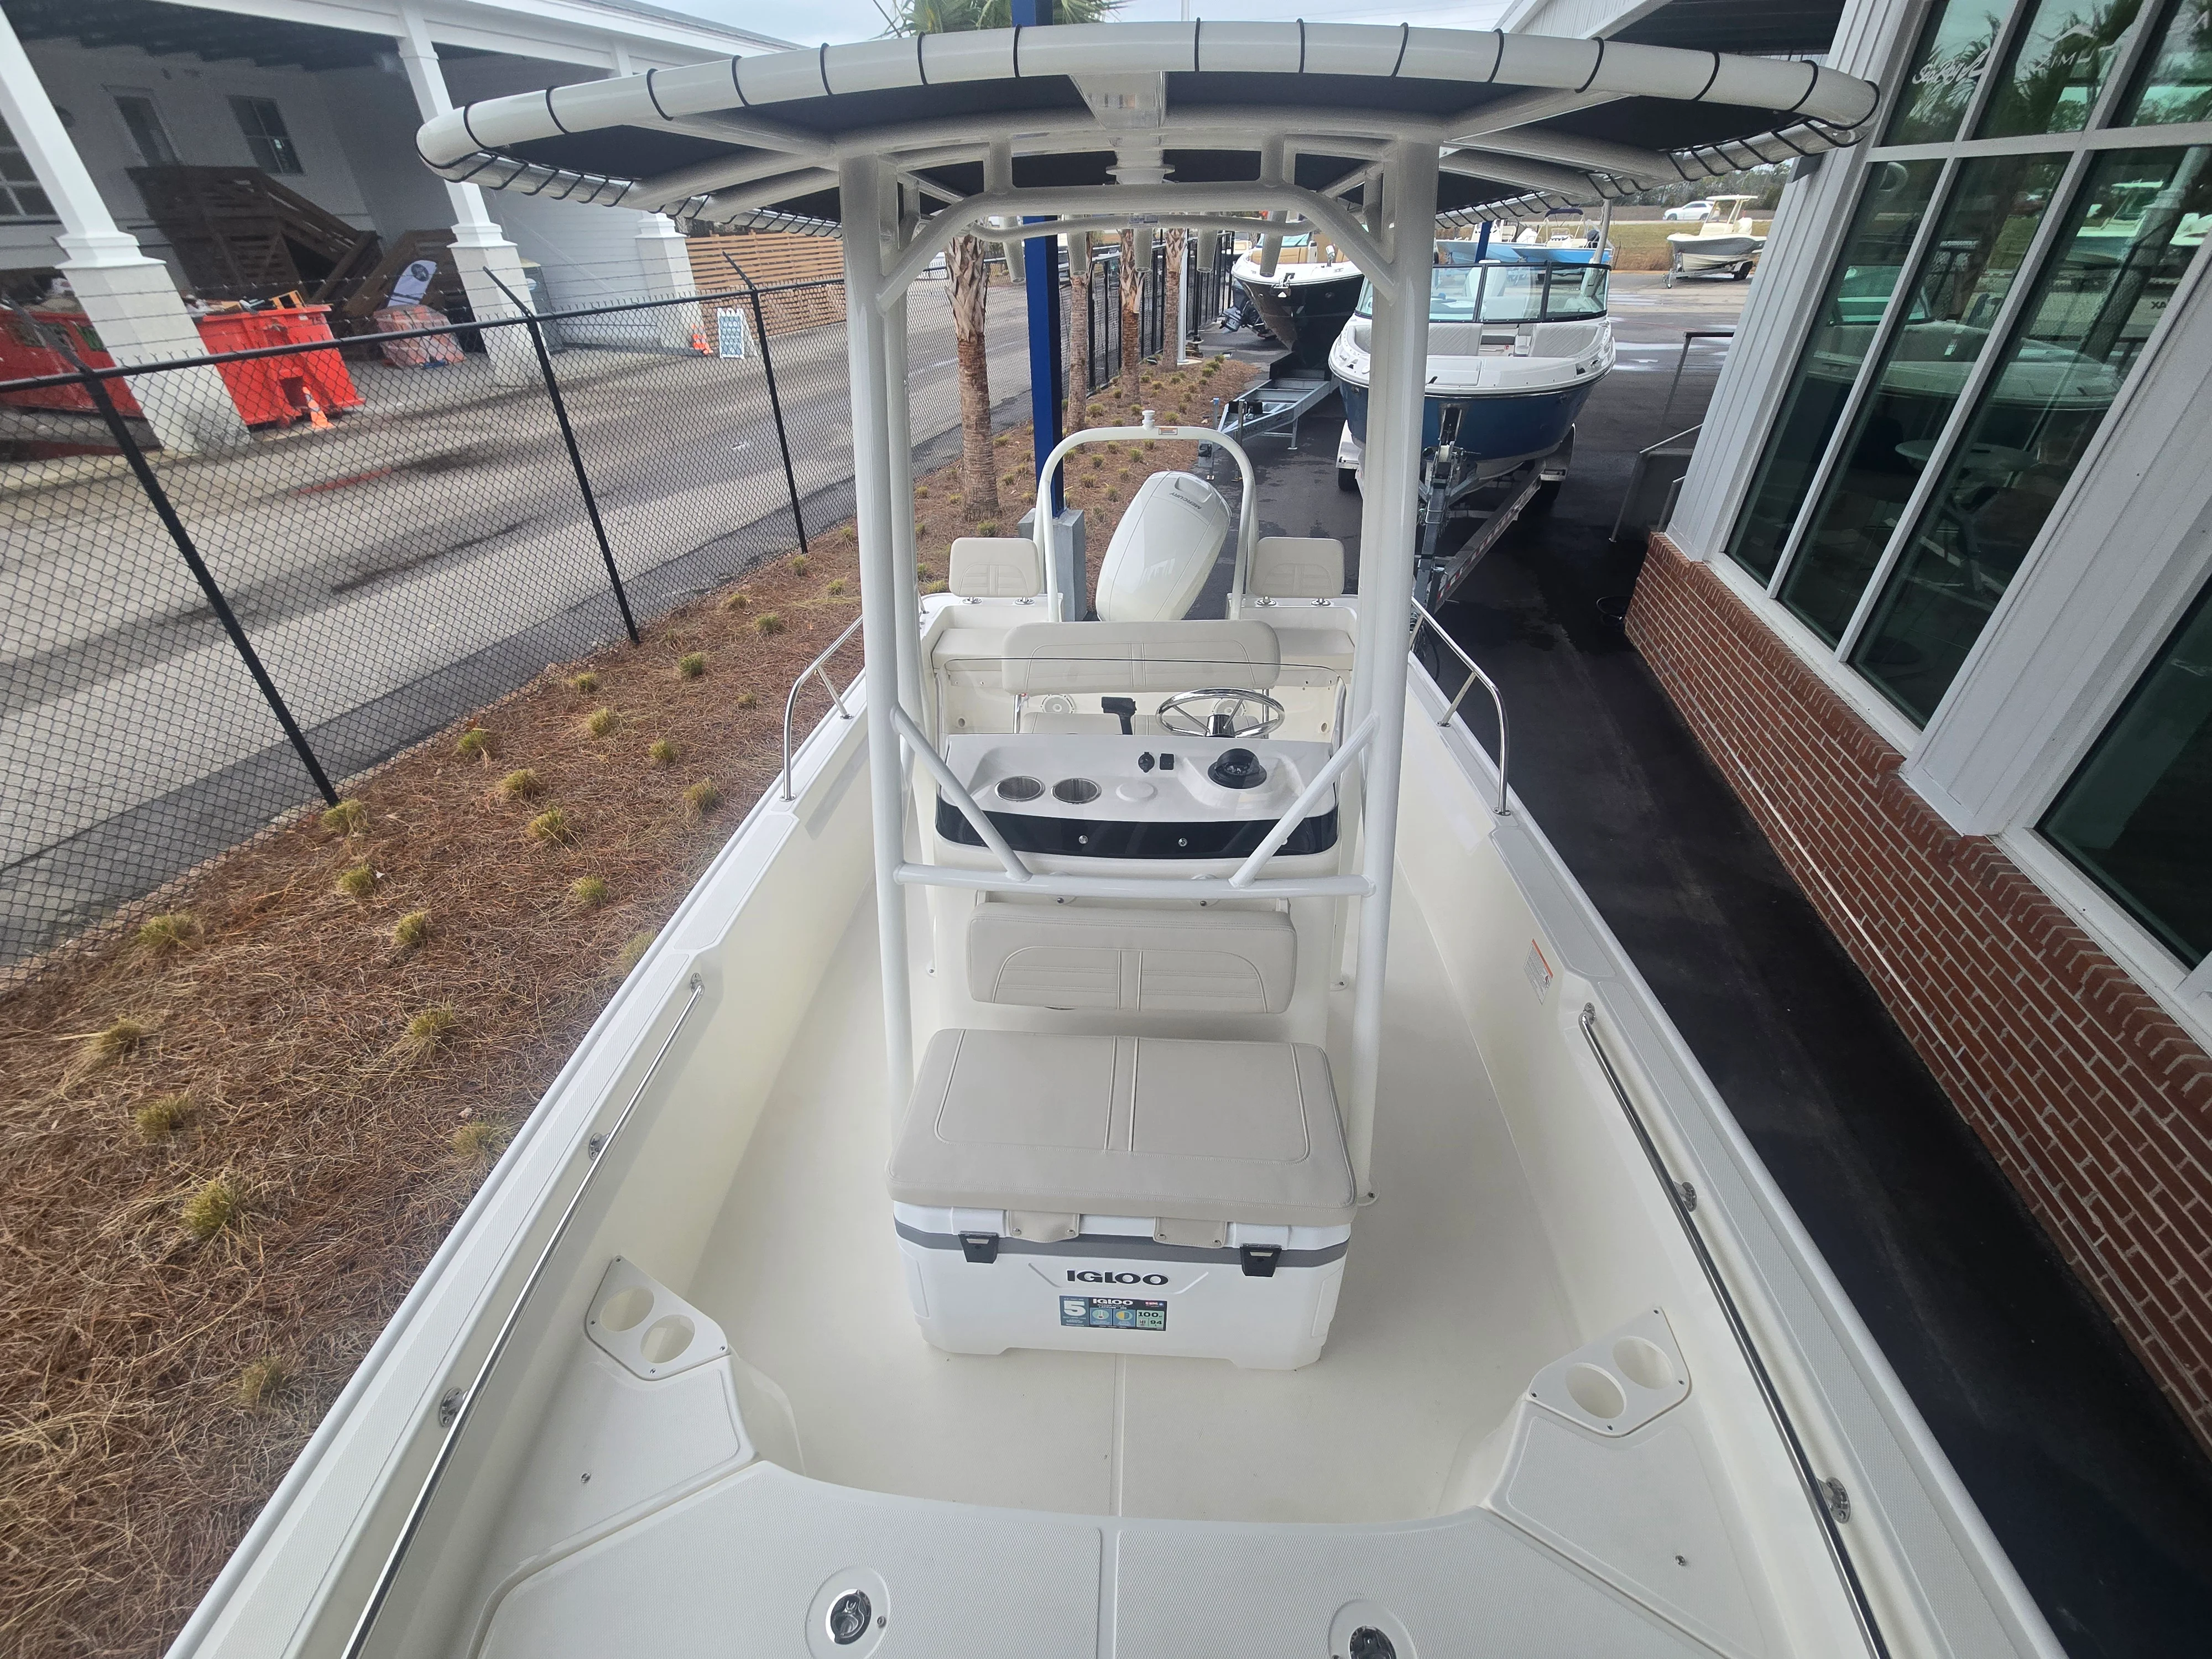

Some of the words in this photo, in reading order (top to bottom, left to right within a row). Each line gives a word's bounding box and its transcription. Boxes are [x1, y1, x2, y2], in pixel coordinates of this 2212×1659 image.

[1169, 492, 1202, 510] MERCURY
[1067, 1270, 1169, 1286] IGLOO
[1063, 1300, 1087, 1317] 5
